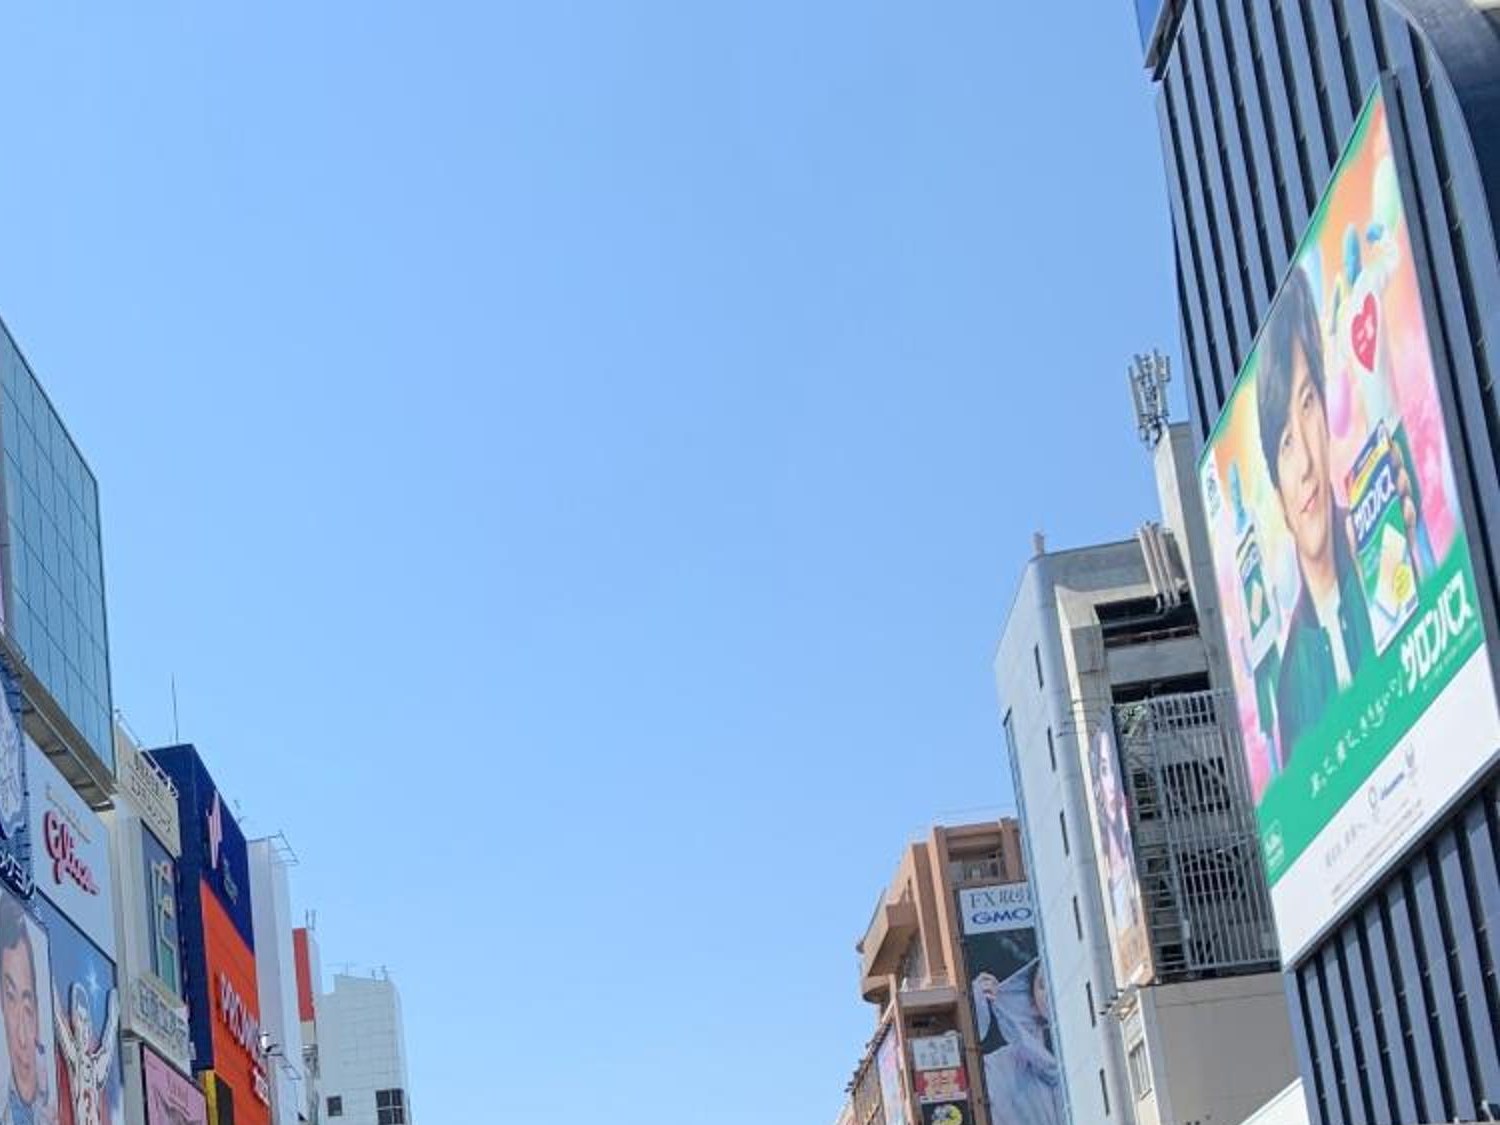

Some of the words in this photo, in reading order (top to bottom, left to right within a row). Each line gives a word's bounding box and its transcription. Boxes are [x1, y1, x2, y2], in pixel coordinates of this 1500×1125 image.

[1401, 570, 1475, 694] サロンパス
[43, 808, 102, 897] Glico
[971, 907, 1032, 925] GMO
